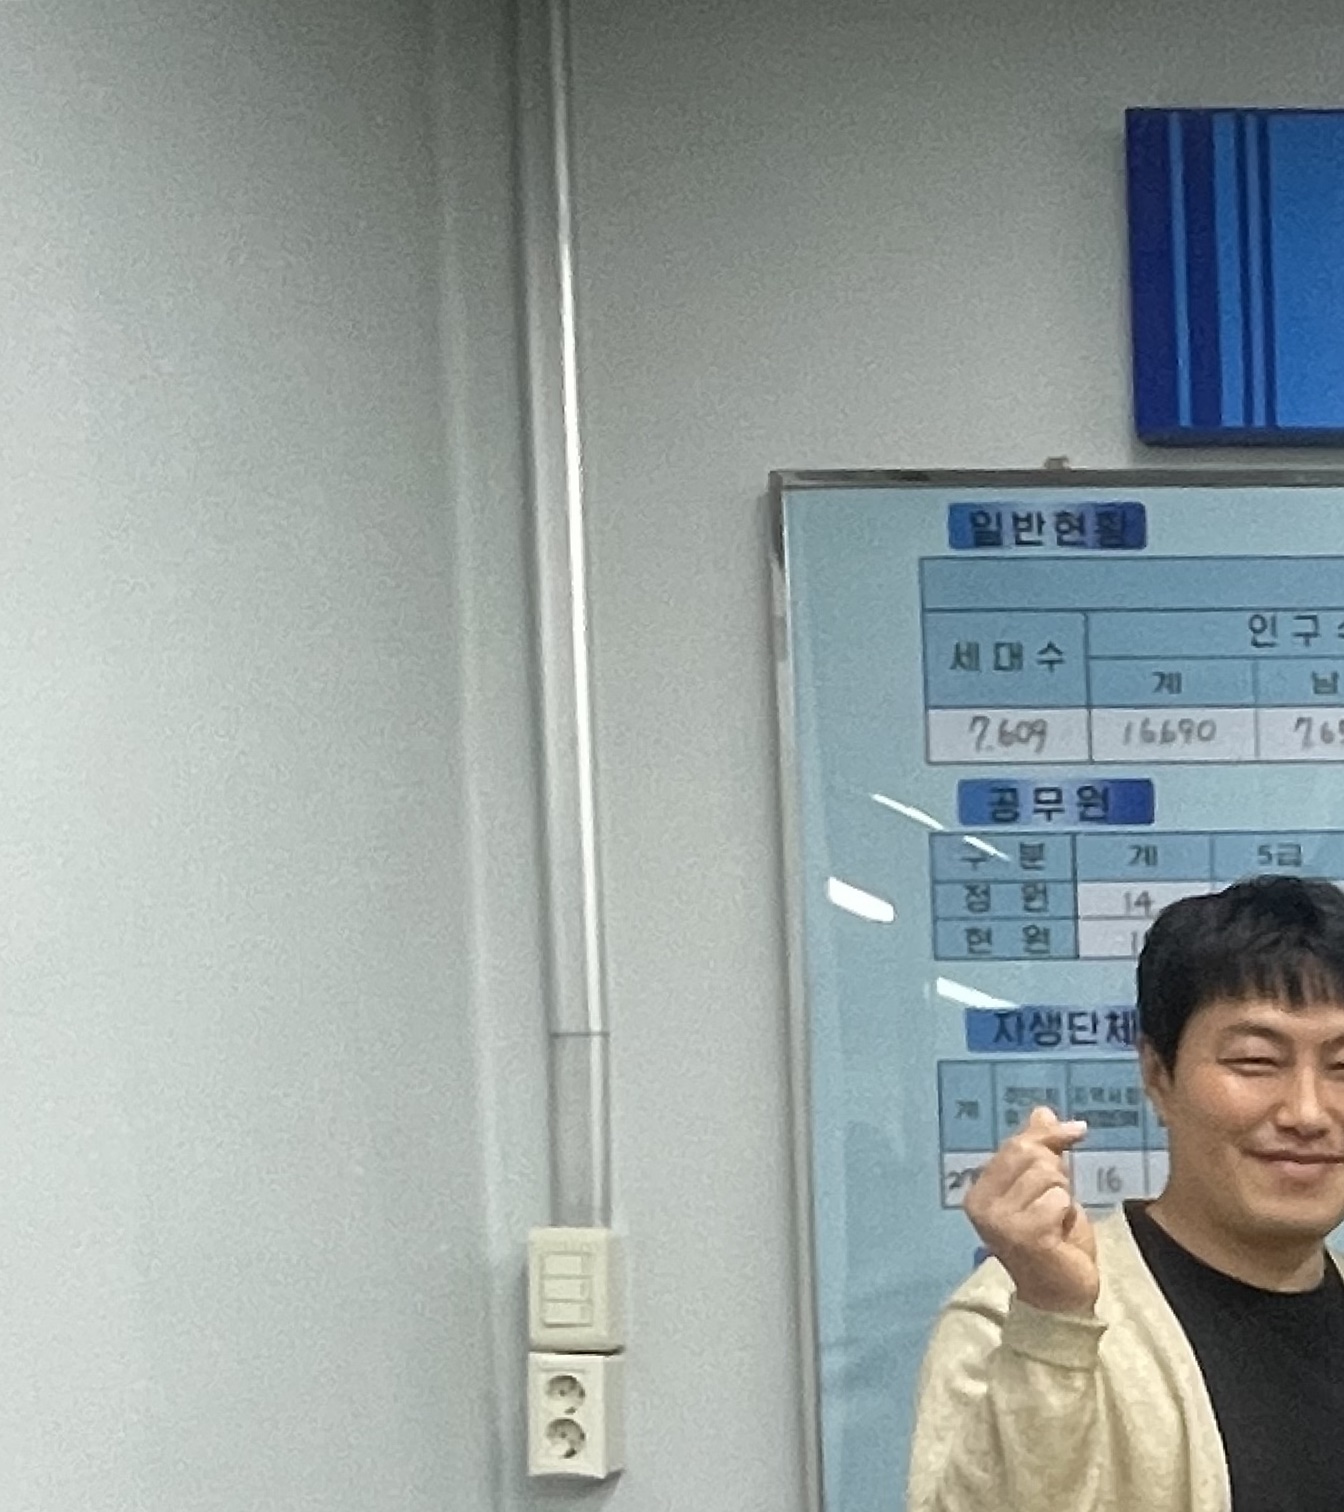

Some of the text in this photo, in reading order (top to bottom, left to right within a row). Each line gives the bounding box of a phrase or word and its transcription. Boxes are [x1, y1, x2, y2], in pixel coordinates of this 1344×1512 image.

[1151, 670, 1184, 695] 계
[1311, 670, 1340, 695] 남
[988, 786, 1110, 825] 공무원
[1127, 845, 1159, 867] 계
[1256, 842, 1303, 868] 5급
[1096, 1165, 1123, 1193] 16
